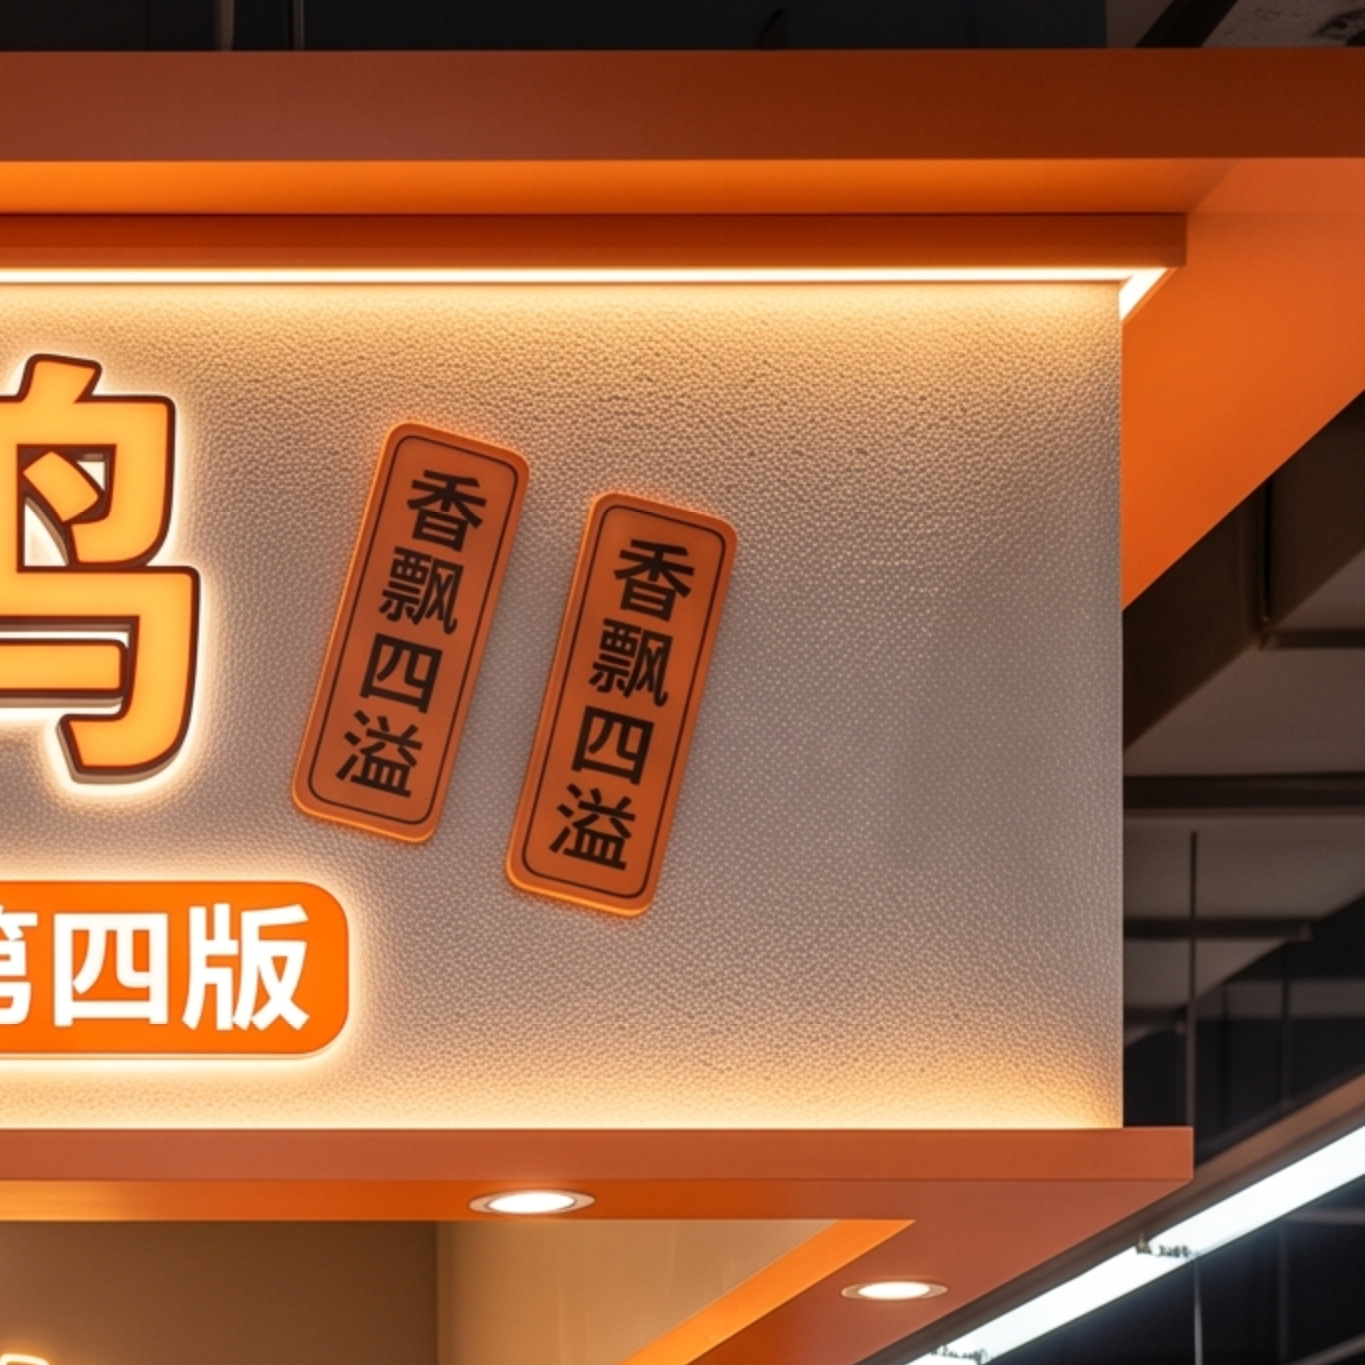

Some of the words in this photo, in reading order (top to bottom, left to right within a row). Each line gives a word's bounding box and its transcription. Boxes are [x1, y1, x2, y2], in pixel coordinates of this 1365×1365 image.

[335, 468, 487, 799] 香飘四溢
[548, 538, 695, 872] 香飘四溢
